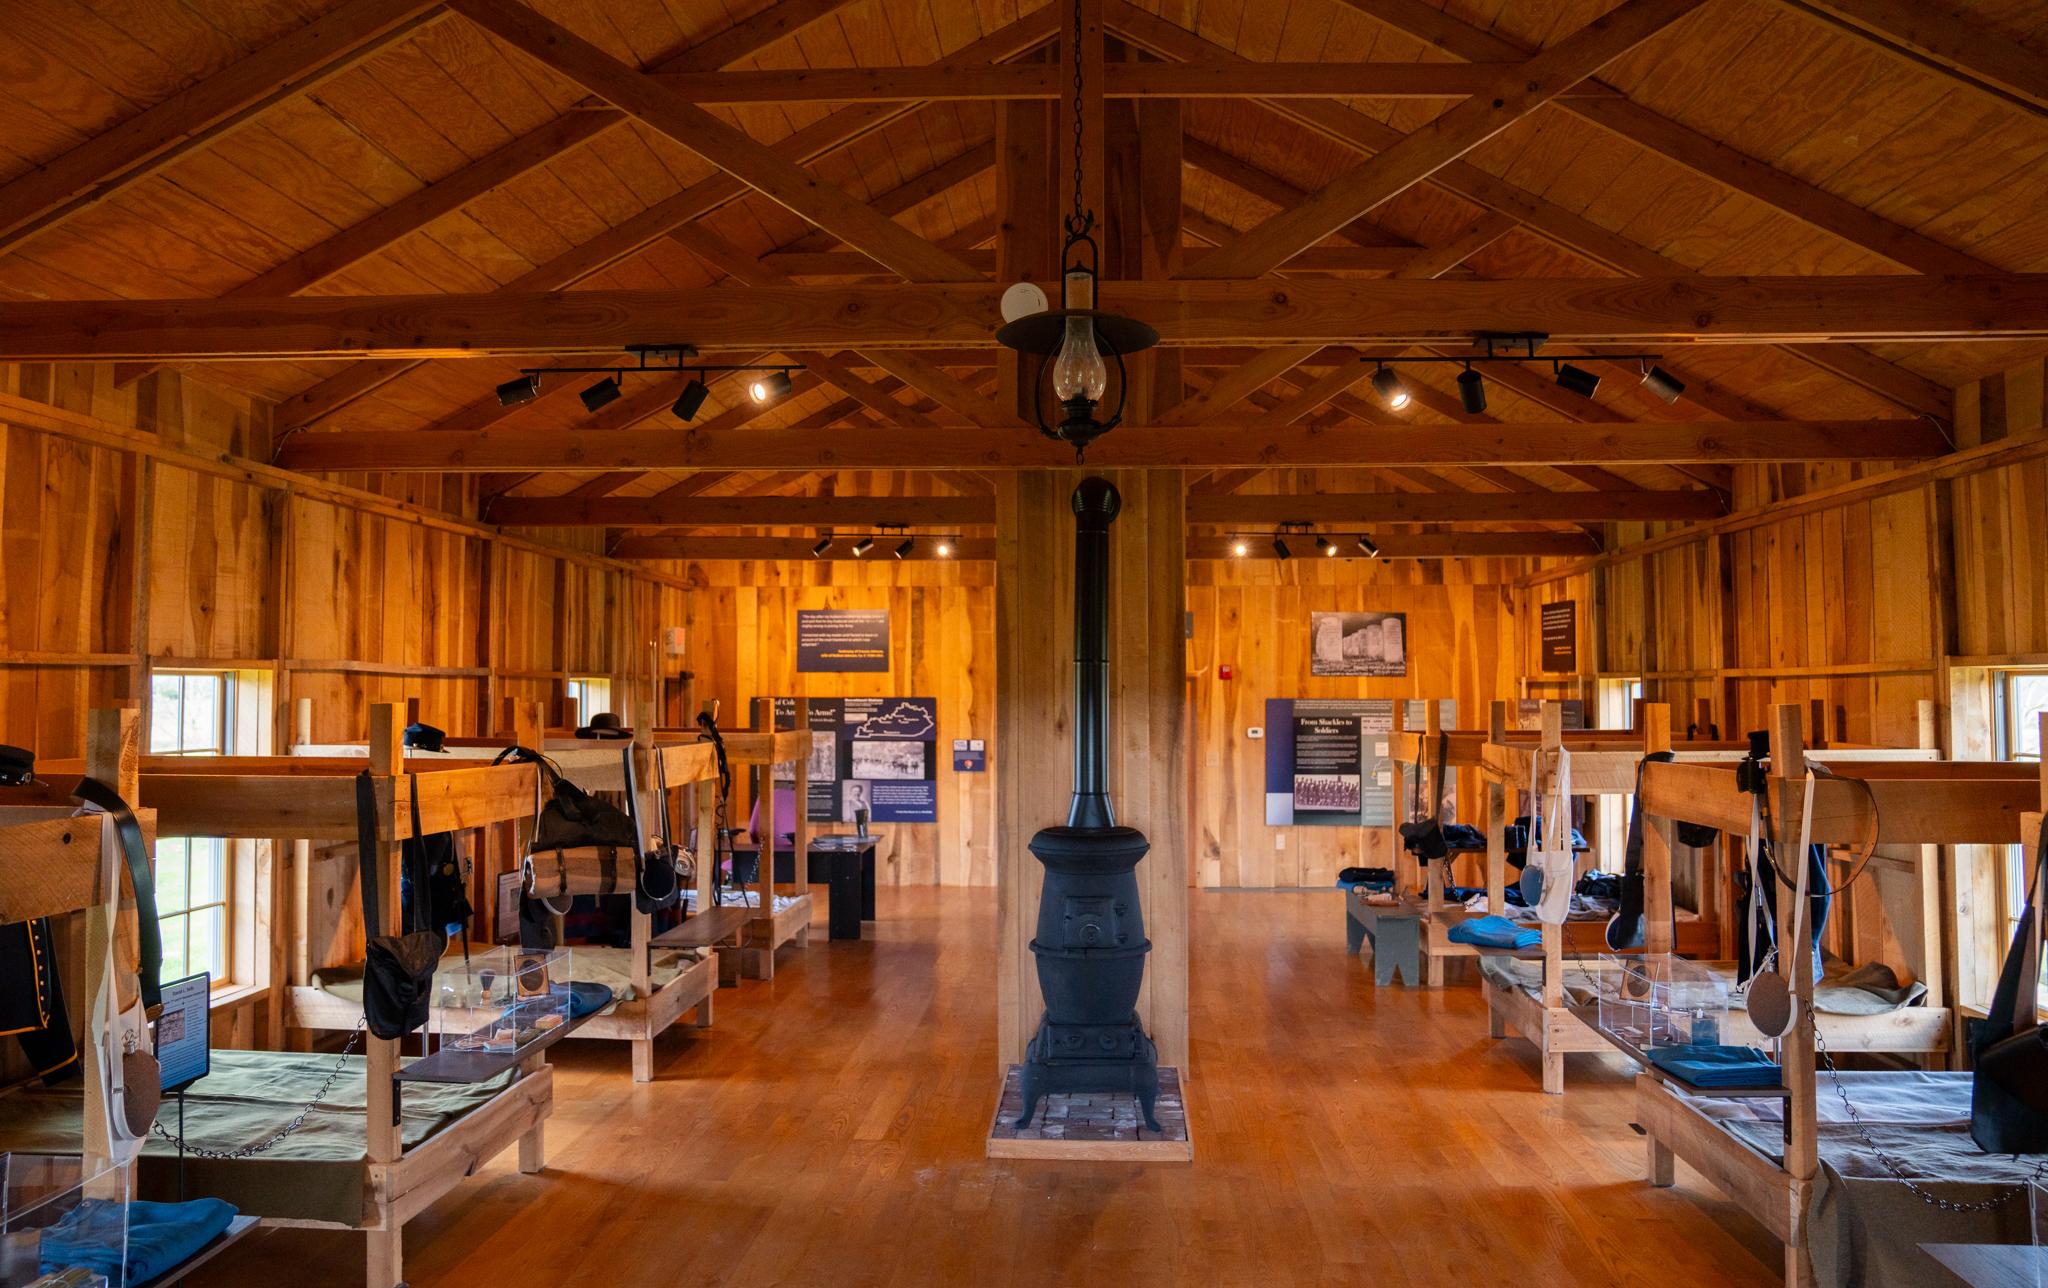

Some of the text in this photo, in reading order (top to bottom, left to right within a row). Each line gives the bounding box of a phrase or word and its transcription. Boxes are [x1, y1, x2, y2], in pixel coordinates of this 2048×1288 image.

[1300, 718, 1318, 726] From
[1318, 718, 1345, 726] Shackles
[1314, 726, 1339, 734] Soldiers
